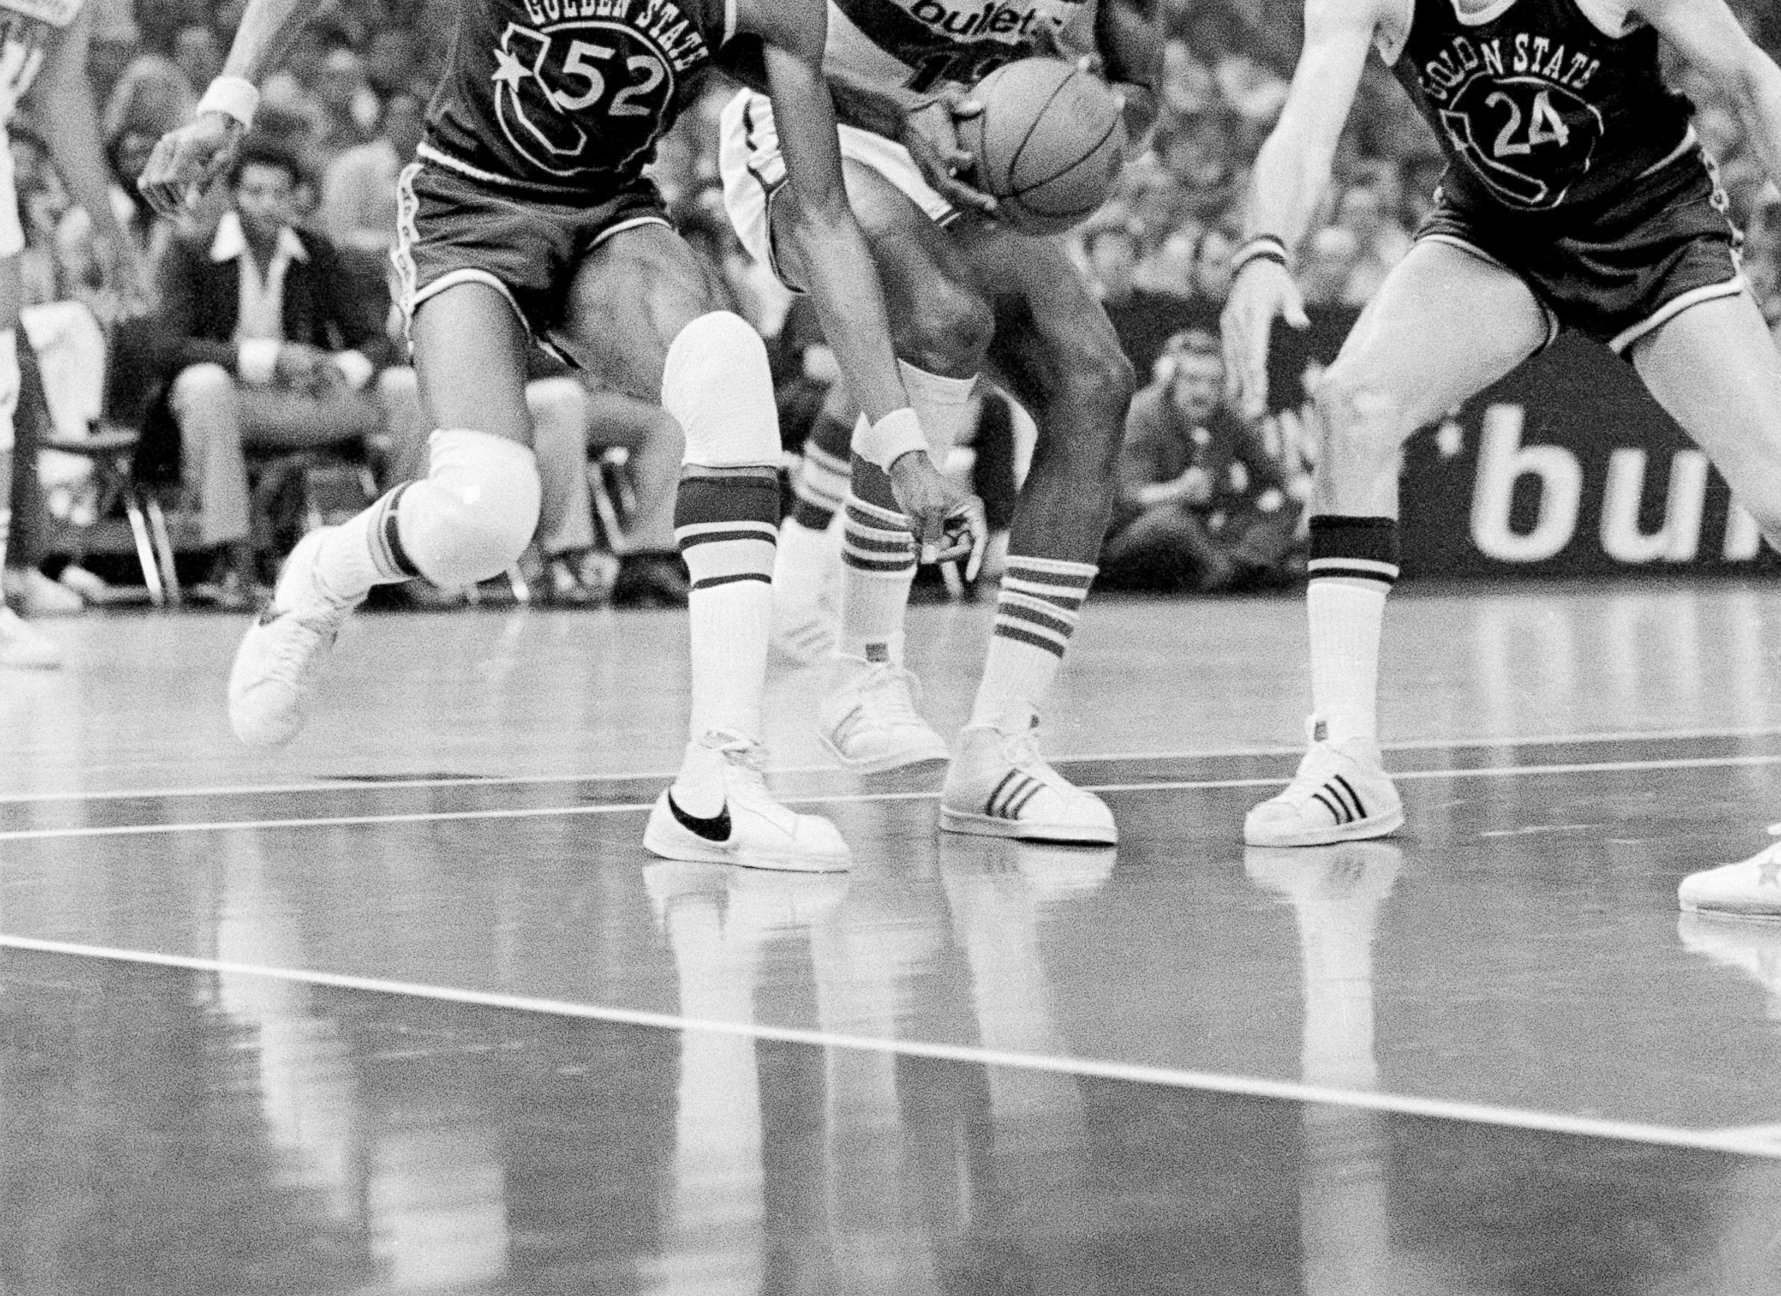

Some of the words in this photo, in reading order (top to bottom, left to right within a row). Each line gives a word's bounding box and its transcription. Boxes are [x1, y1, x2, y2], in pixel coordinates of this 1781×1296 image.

[551, 39, 666, 116] 52
[1513, 32, 1601, 90] STATE
[1484, 90, 1570, 158] 24
